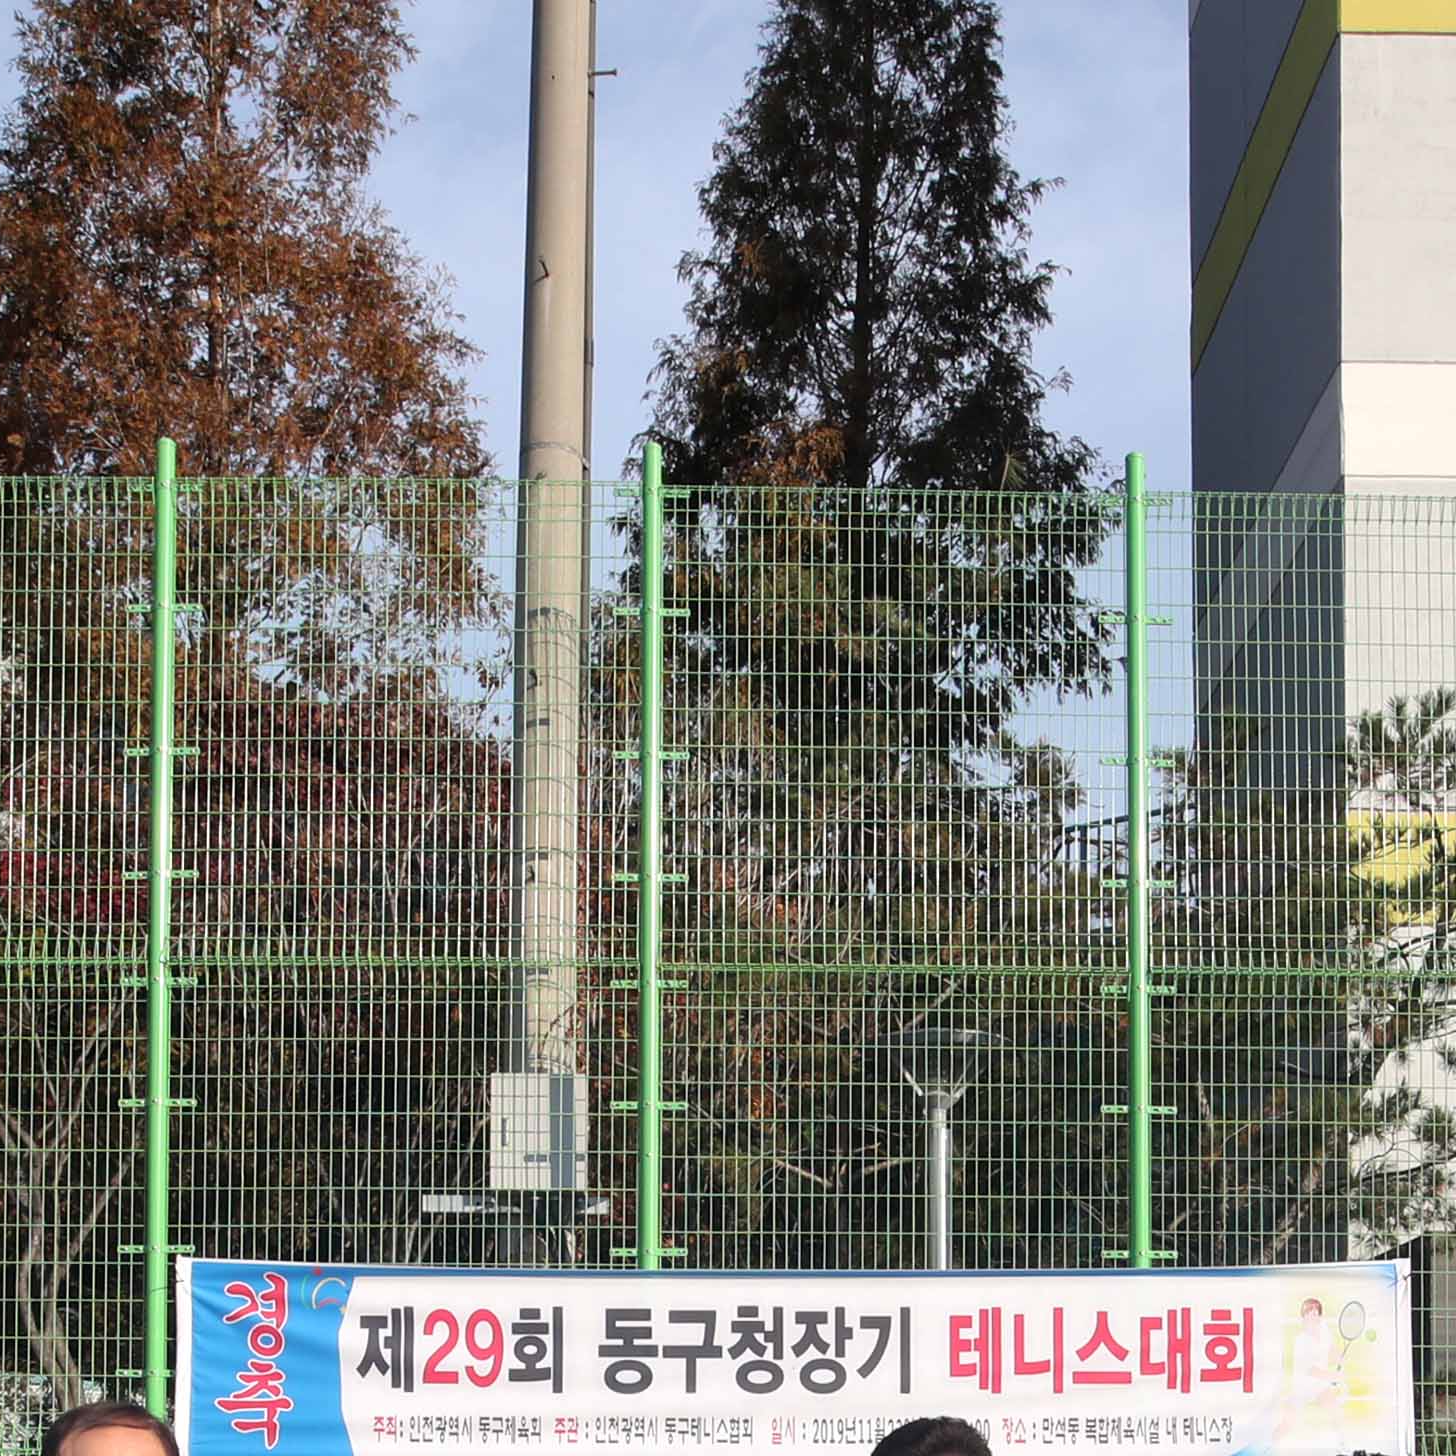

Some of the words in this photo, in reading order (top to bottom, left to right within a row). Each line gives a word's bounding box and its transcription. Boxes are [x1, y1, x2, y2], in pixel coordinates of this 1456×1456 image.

[215, 1271, 292, 1450] 경축
[356, 1306, 563, 1393] 제29회
[598, 1305, 910, 1394] 동구청장기
[949, 1306, 1254, 1394] 테니스대회
[409, 1415, 473, 1443] 인천광역시
[478, 1415, 542, 1443] 동구체육회
[595, 1415, 658, 1444] 인천광역시
[664, 1416, 753, 1445] 동구테니스협회
[1043, 1416, 1080, 1445] 만석동
[1085, 1416, 1160, 1445] 복합체육시설
[1166, 1416, 1178, 1445] 내
[1183, 1416, 1233, 1445] 테니스장
